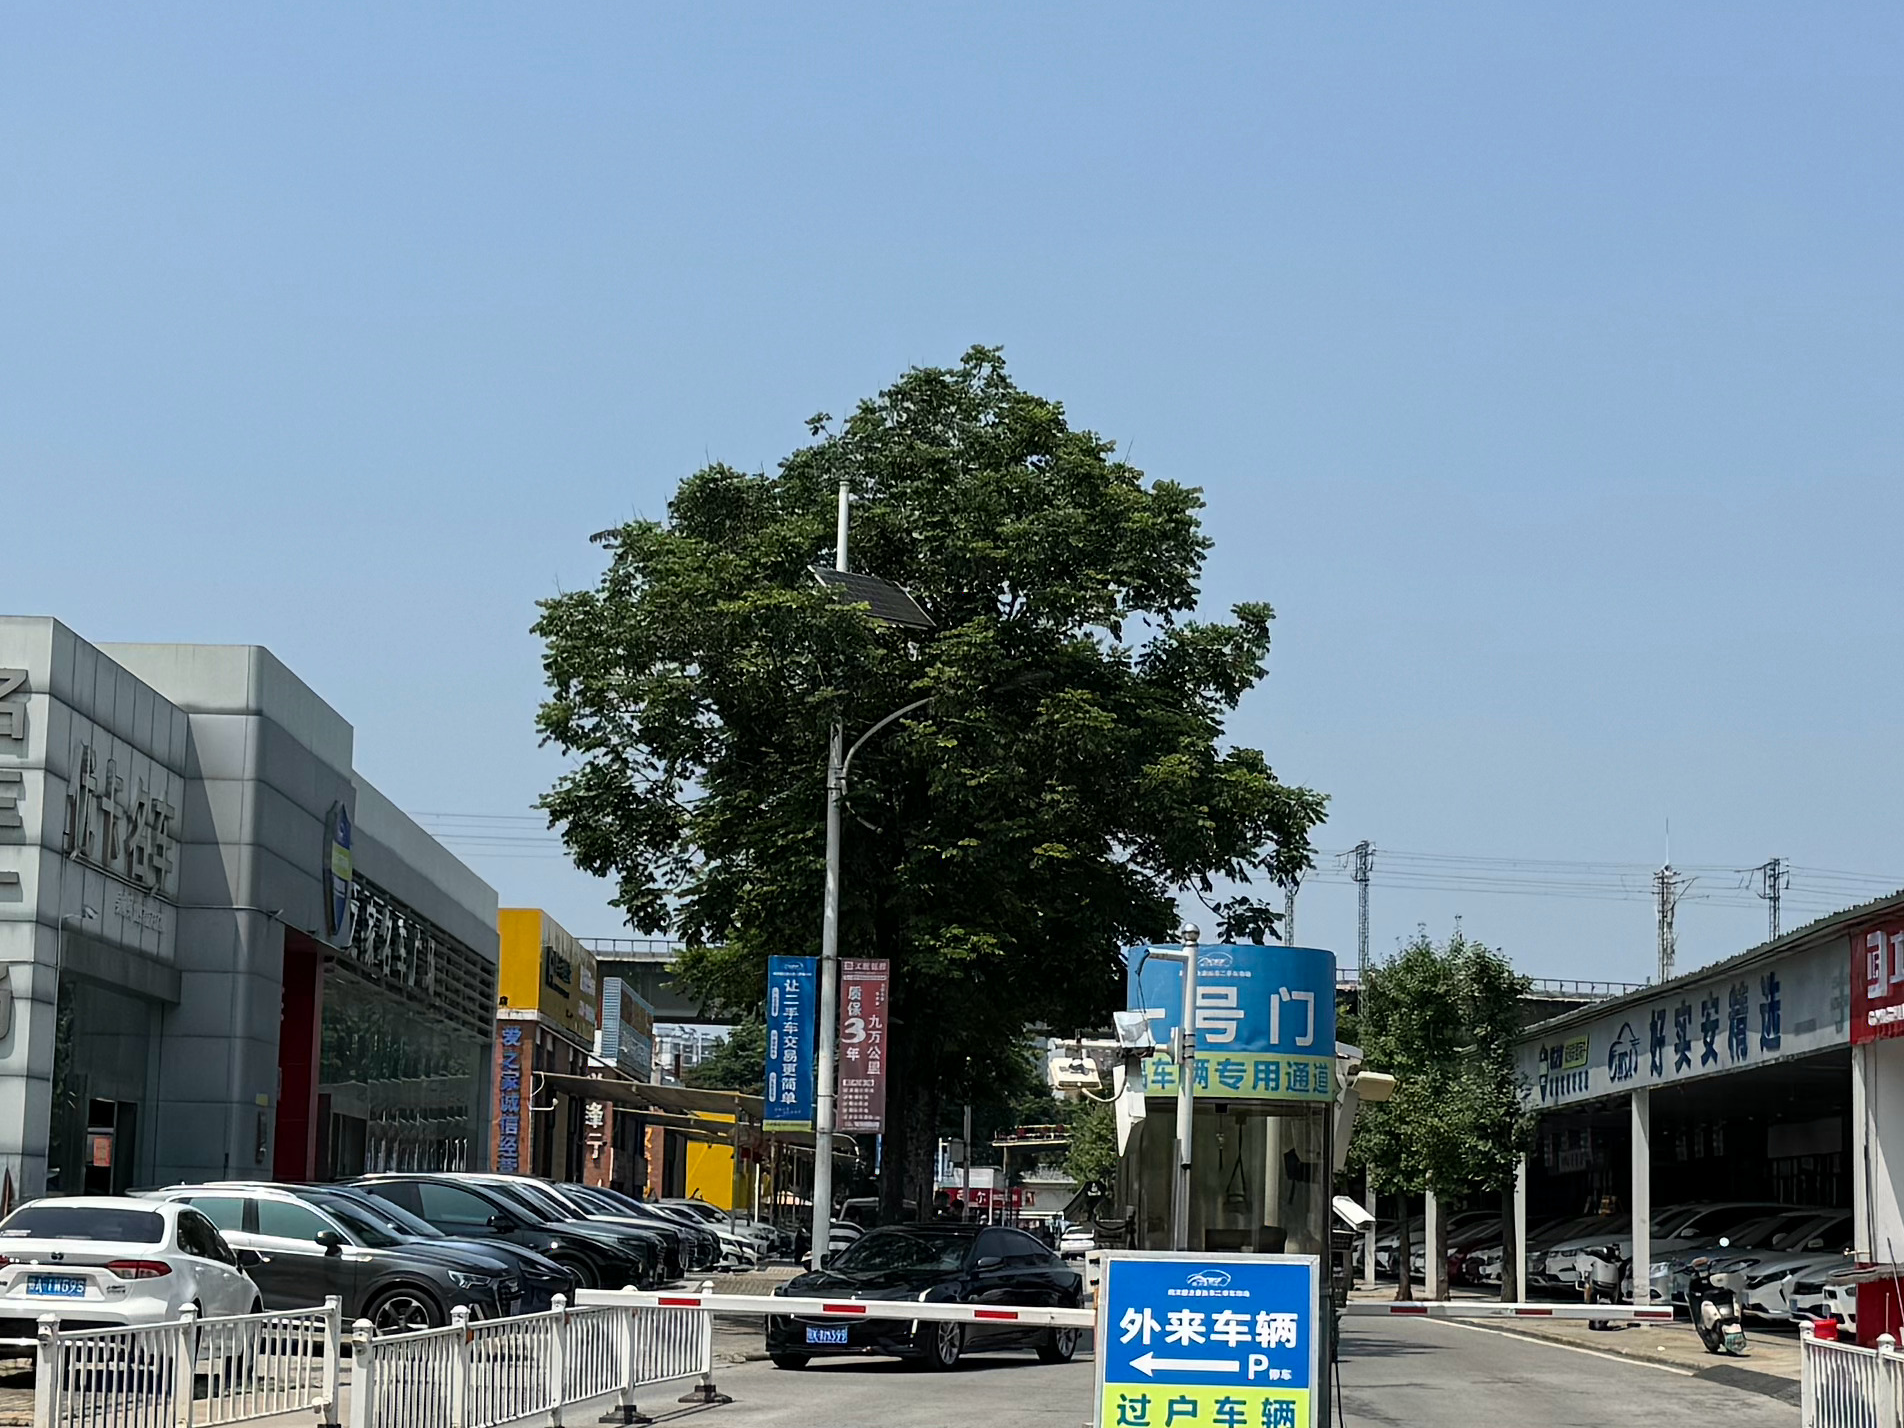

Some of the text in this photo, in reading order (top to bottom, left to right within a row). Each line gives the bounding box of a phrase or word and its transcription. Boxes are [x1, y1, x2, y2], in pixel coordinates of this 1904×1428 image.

[779, 979, 800, 1105] 让二手车交易更简单
[1119, 1307, 1299, 1348] 外来车辆
[1248, 1354, 1269, 1380] P
